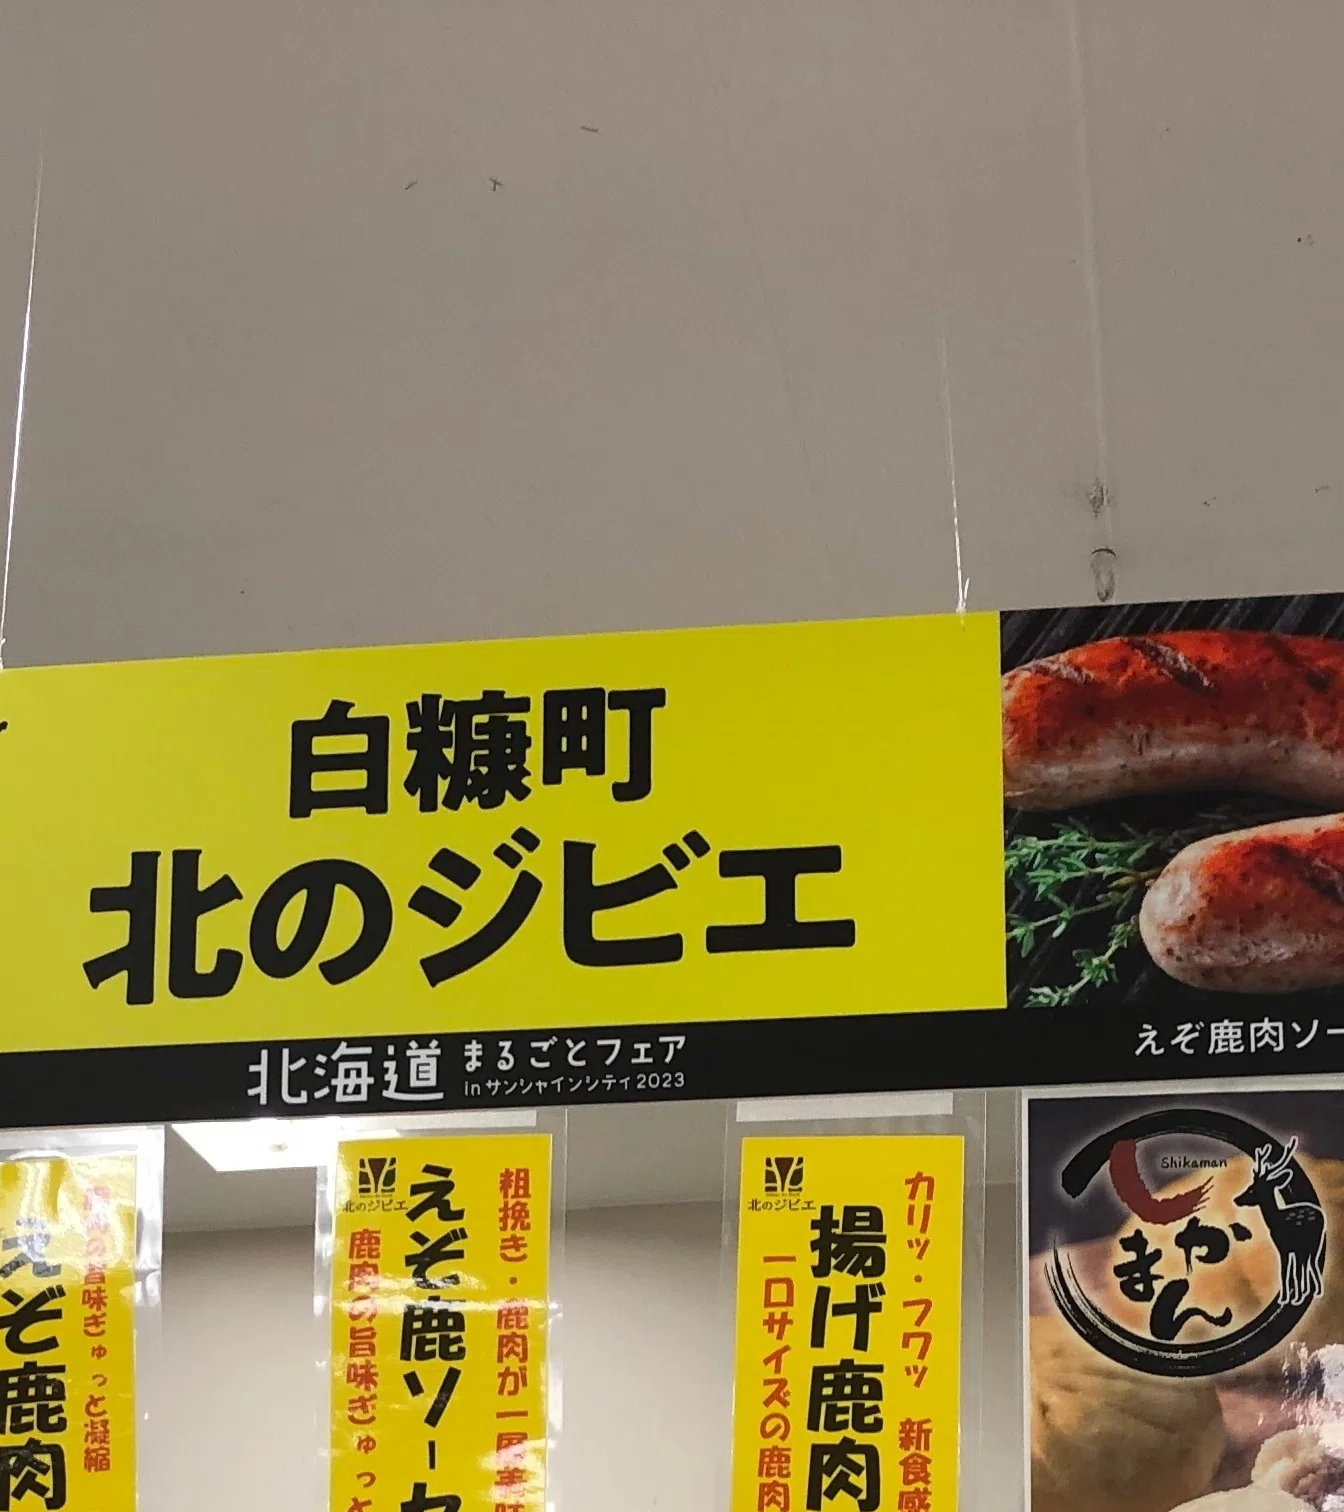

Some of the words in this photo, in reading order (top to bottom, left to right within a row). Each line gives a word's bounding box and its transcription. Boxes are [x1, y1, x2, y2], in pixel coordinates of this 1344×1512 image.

[289, 687, 666, 818] 白糠町
[82, 826, 856, 1006] 北のジビエ
[247, 1039, 445, 1106] 北海道
[463, 1035, 686, 1072] まるごとフェア
[1160, 1155, 1228, 1170] Shikaman
[342, 1199, 409, 1213] 北のジビエ
[747, 1198, 817, 1212] 北のジビエ
[901, 1171, 936, 1389] カリッ・フワッ
